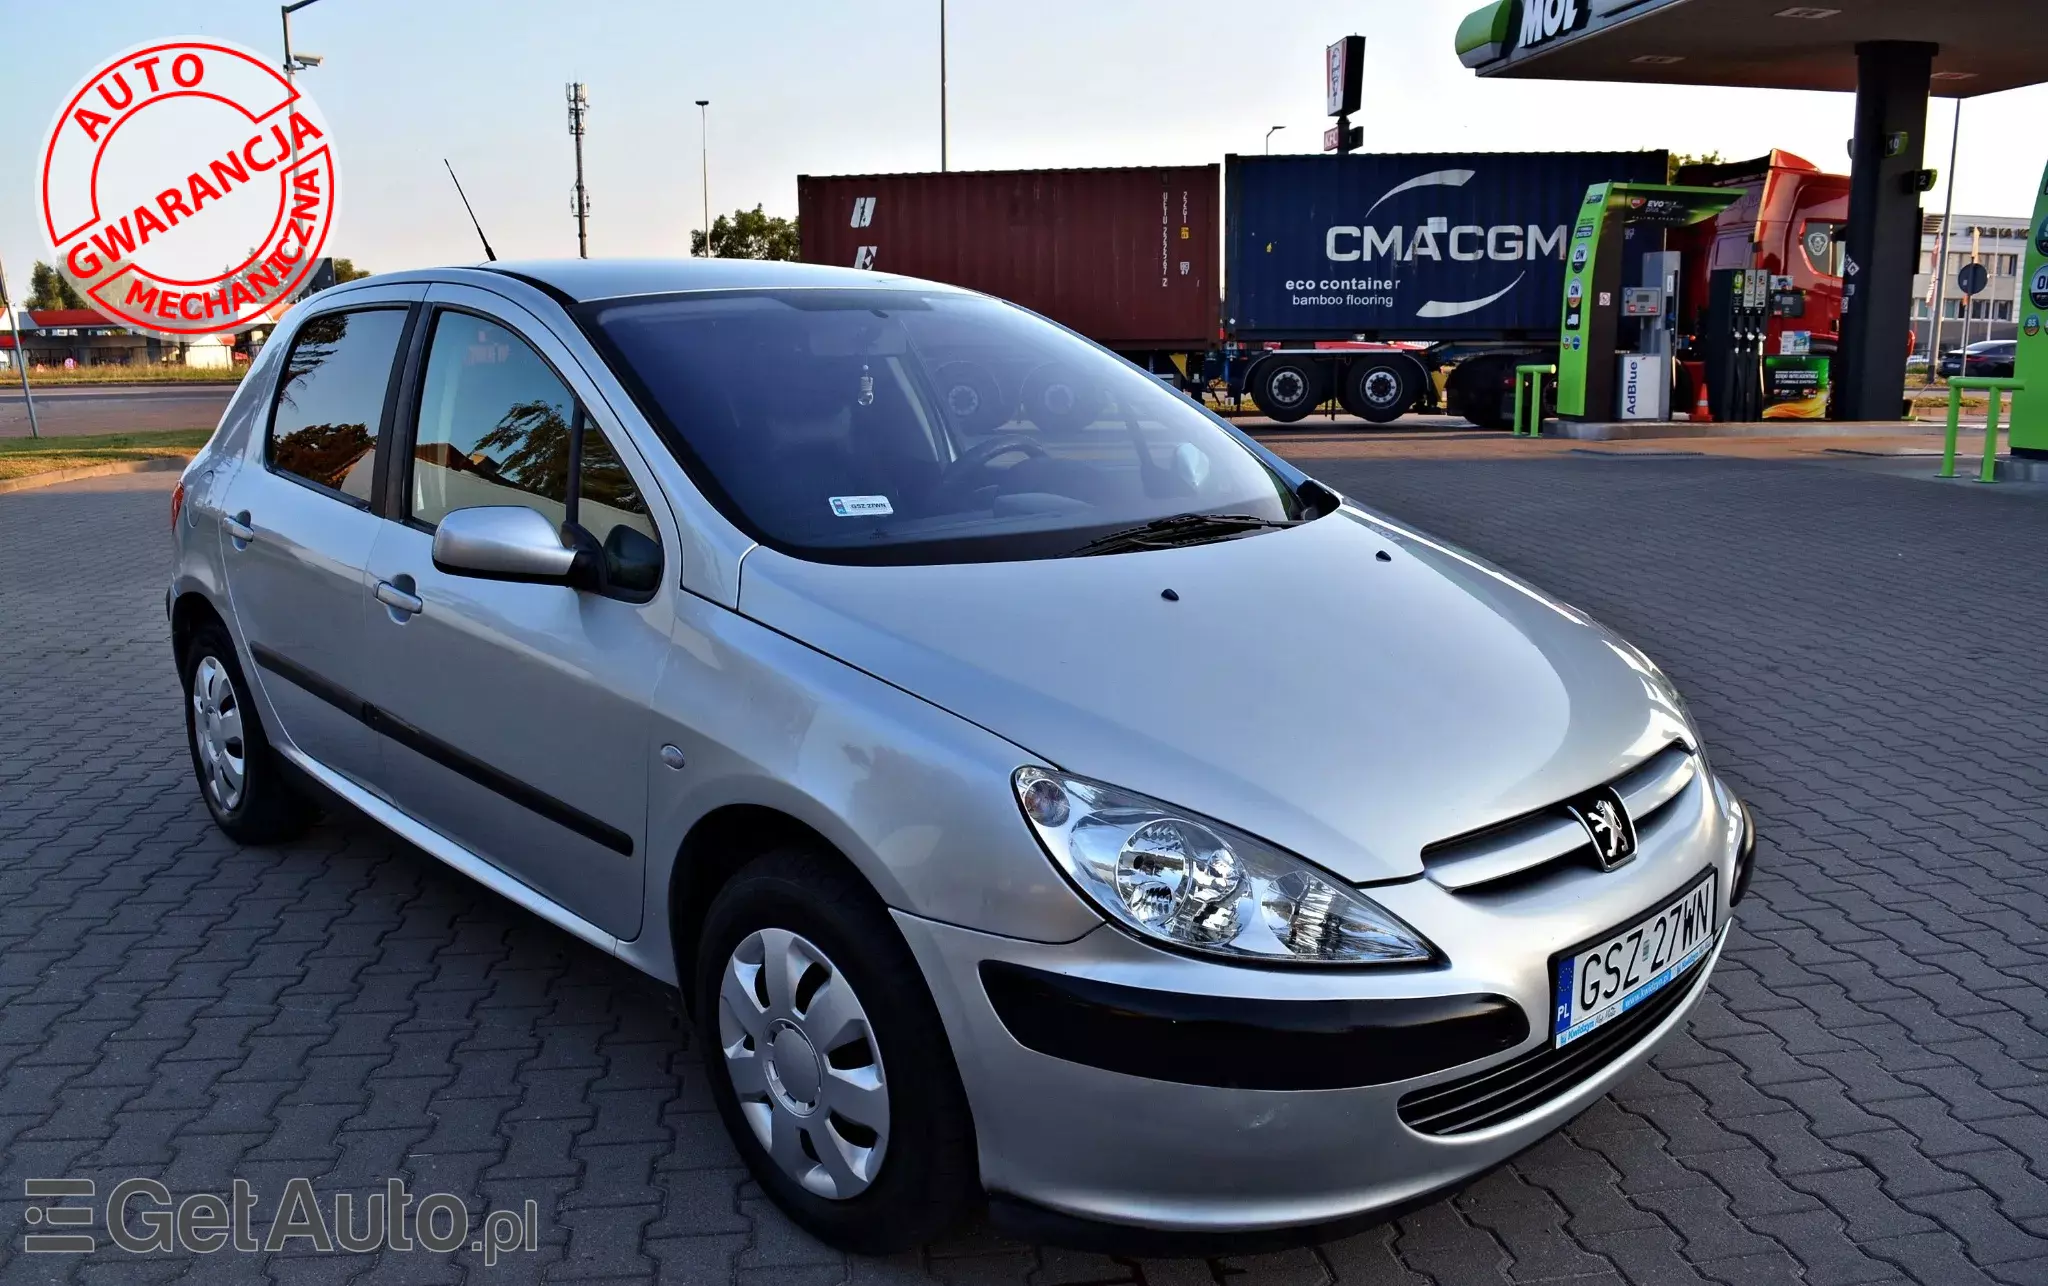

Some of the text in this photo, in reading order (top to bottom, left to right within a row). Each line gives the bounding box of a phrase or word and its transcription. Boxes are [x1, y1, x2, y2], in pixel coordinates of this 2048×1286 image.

[1518, 0, 1578, 47] MOL
[1919, 175, 1927, 186] 2
[1286, 277, 1401, 290] eco container
[1292, 294, 1393, 307] bamboo flooring
[1626, 361, 1638, 415] AdBlue
[1580, 882, 1709, 1011] GSZ 27WN
[1557, 1004, 1570, 1022] PL
